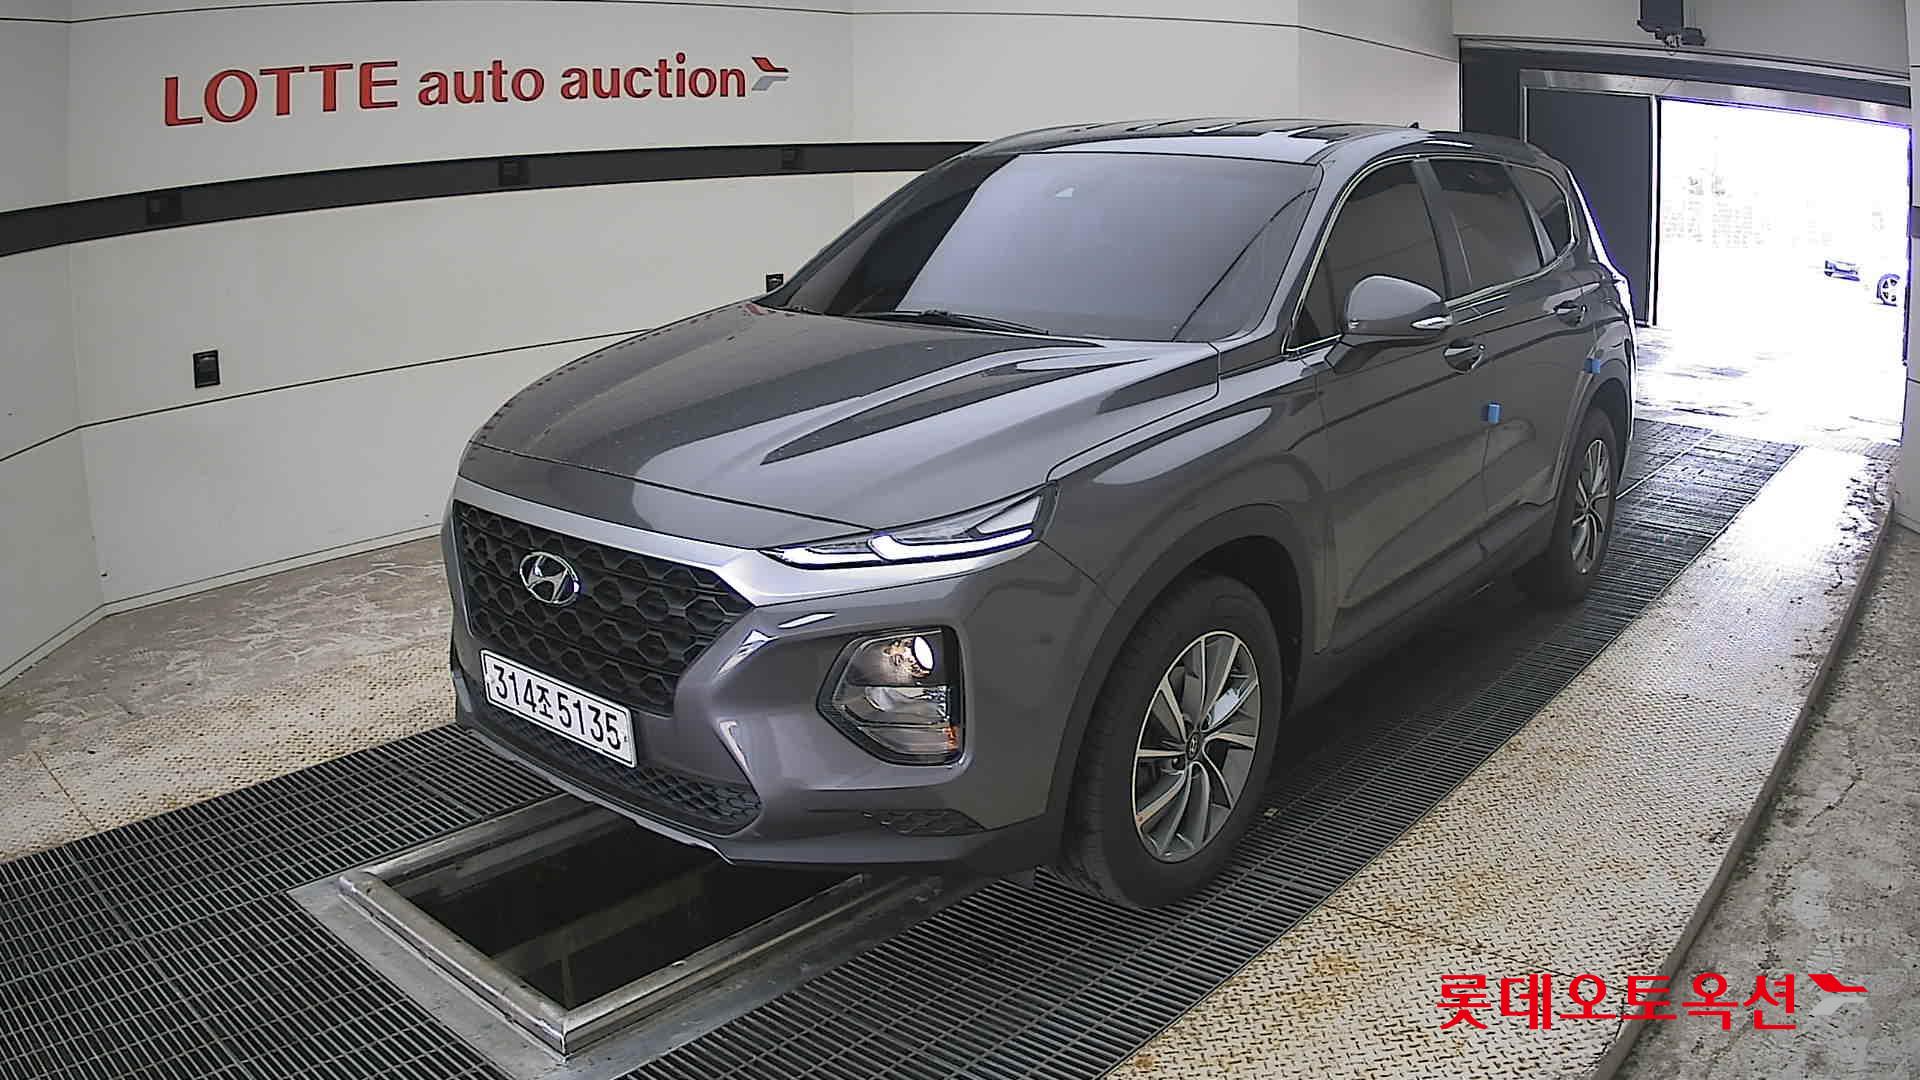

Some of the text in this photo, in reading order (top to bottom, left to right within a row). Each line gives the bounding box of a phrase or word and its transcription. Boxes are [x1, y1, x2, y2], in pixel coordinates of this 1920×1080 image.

[164, 52, 747, 127] LOTTE auto auction
